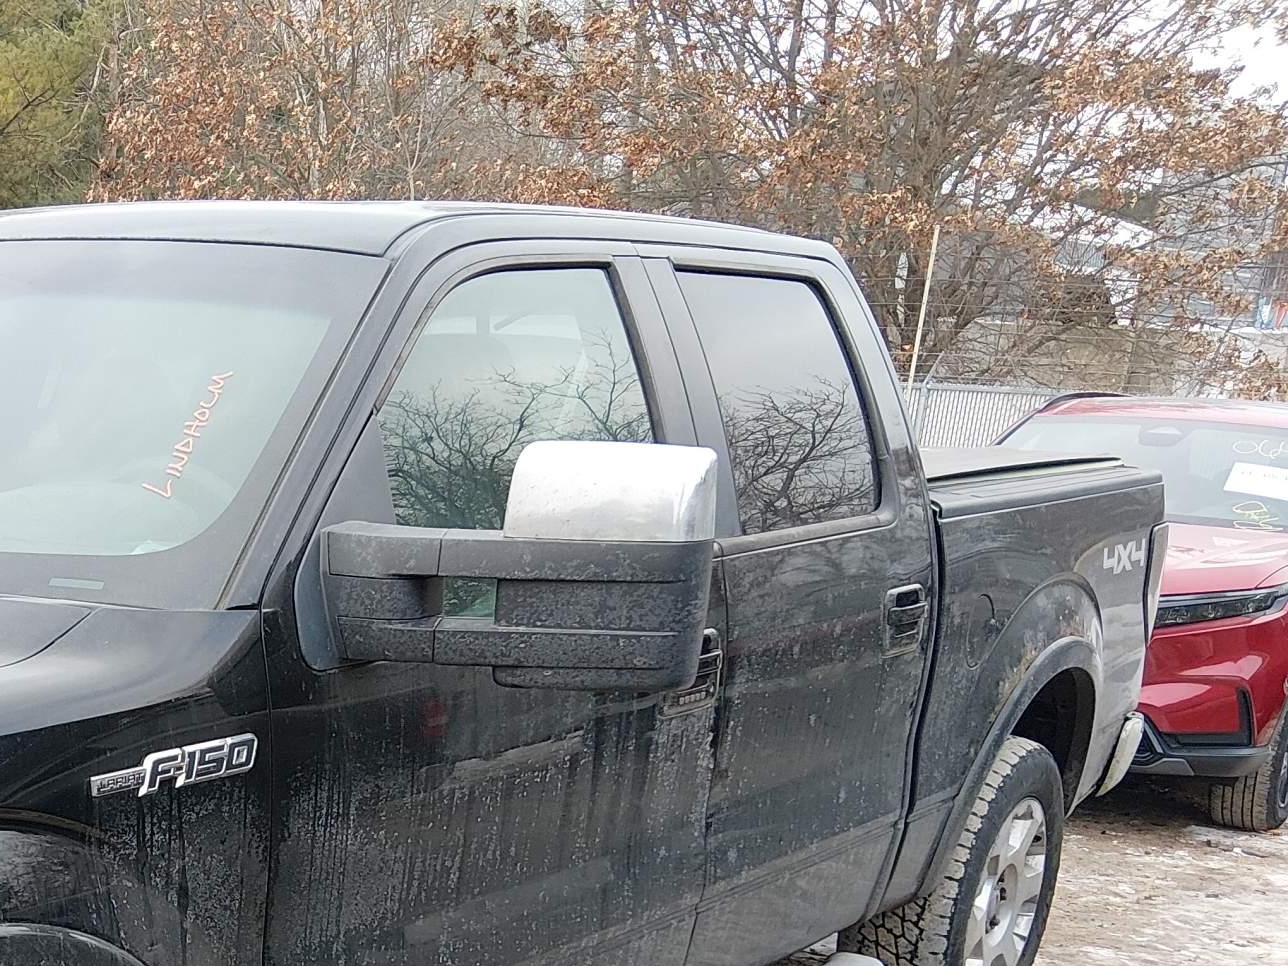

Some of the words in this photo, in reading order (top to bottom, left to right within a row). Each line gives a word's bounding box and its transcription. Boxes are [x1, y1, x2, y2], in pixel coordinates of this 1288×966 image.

[141, 371, 234, 499] LINDHOLM
[96, 771, 145, 794] LARIAT
[138, 733, 259, 798] F-150
